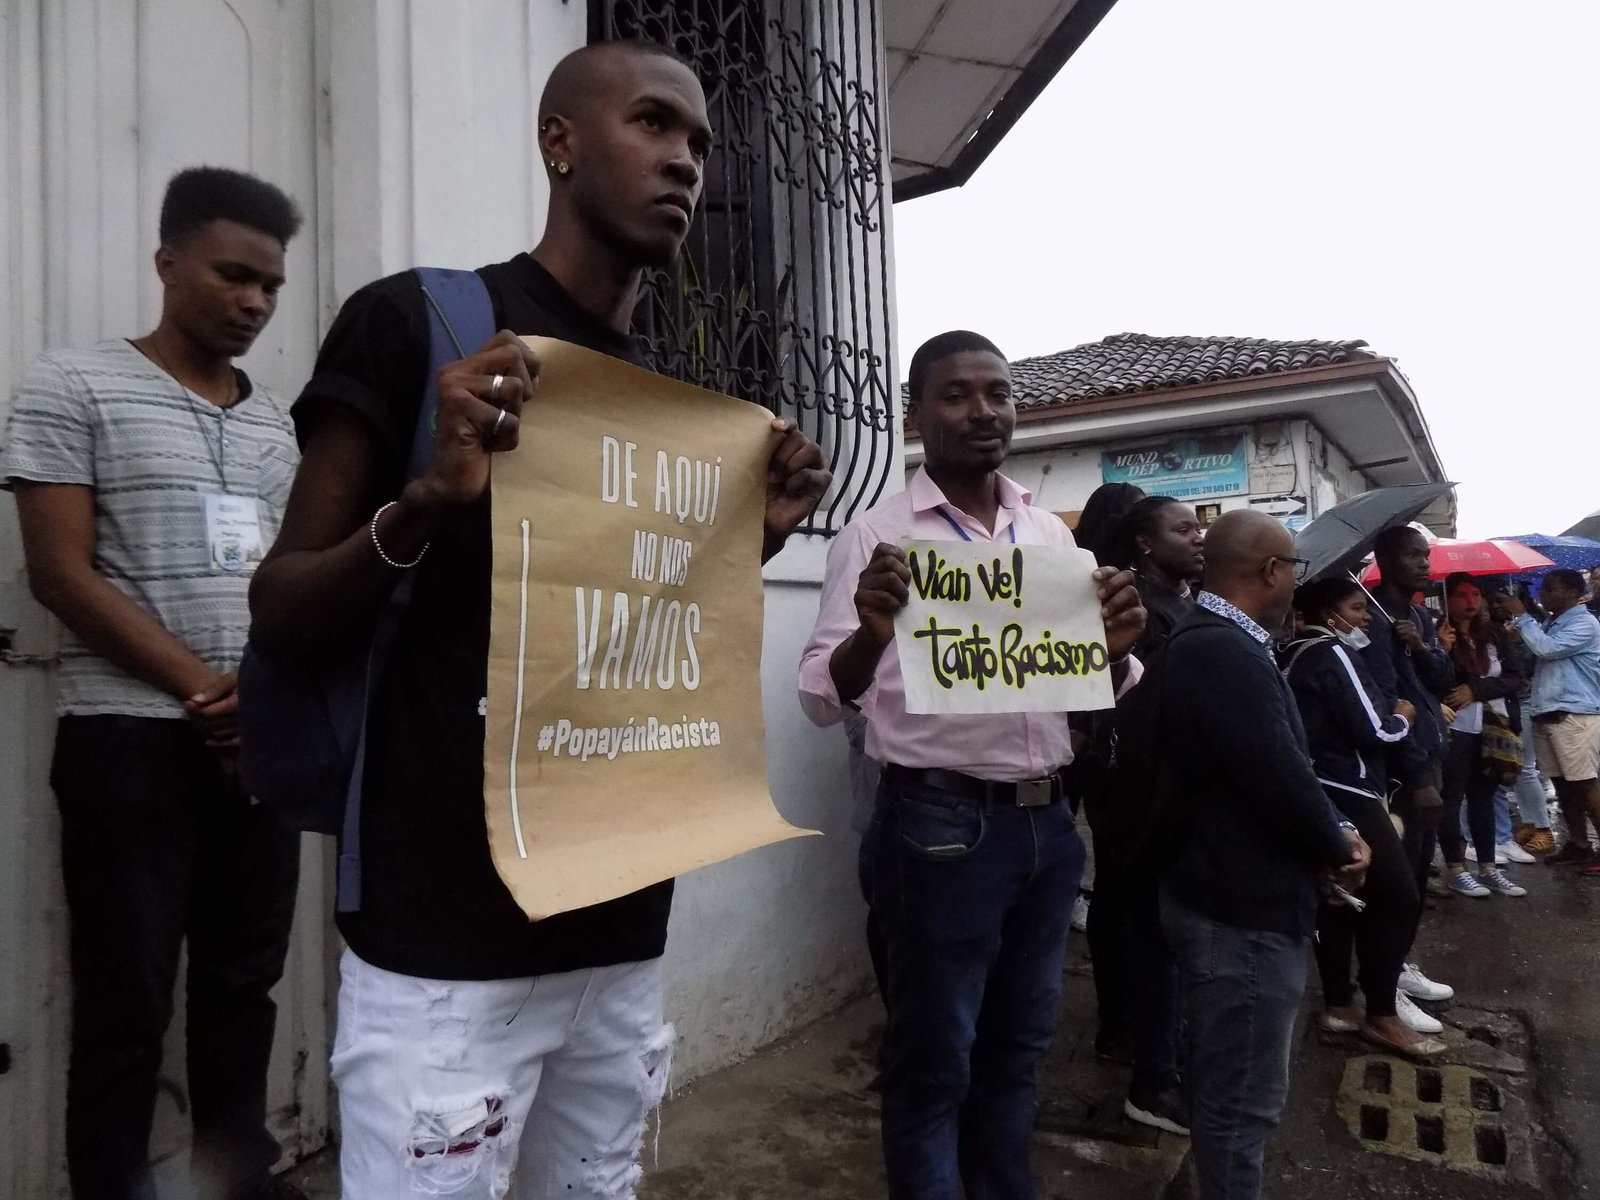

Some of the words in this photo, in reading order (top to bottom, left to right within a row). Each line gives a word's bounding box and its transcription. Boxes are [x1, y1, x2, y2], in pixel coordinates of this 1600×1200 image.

[602, 435, 638, 508] DE
[631, 530, 658, 582] NO
[659, 535, 692, 587] NOS
[909, 549, 971, 601] Vían
[977, 548, 1024, 608] Ve!
[575, 586, 701, 691] VAMOS
[1000, 623, 1109, 689] Racismo
[537, 715, 721, 762] #PopayánRacista
